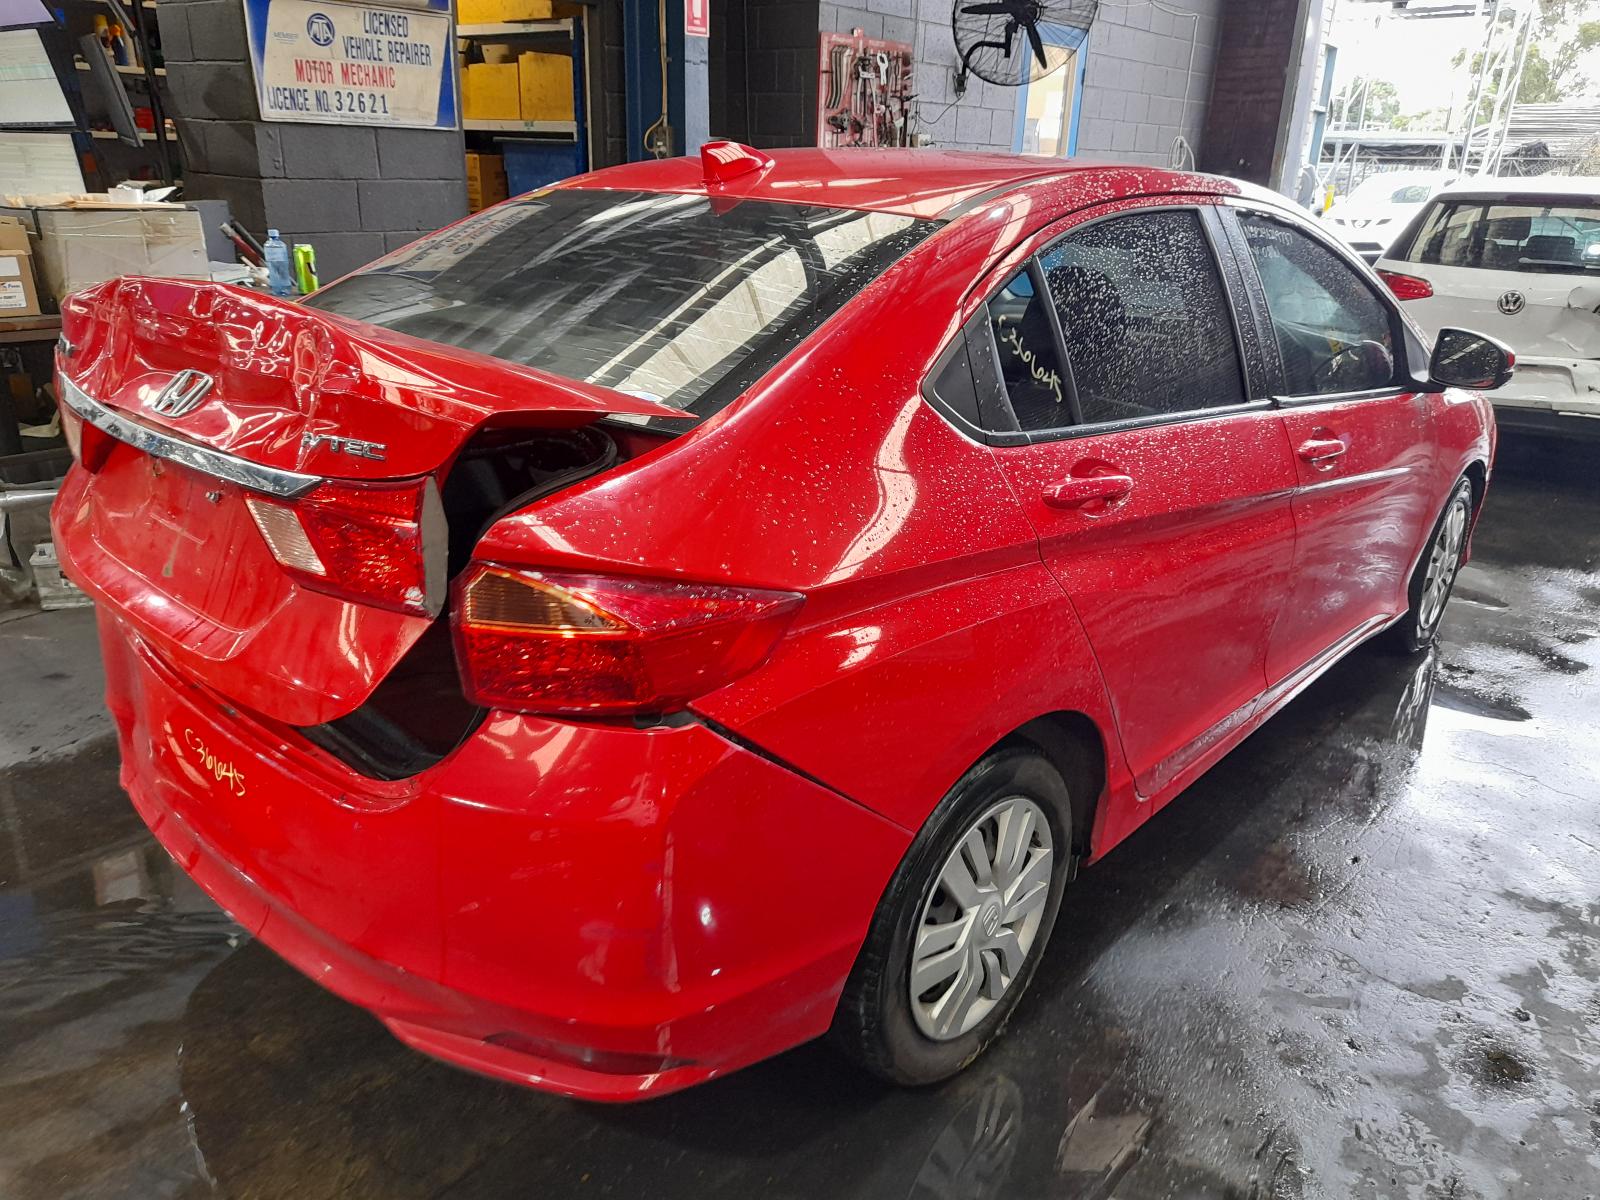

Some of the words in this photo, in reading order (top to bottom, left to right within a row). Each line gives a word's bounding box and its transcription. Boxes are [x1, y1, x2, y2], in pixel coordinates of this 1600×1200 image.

[363, 11, 409, 38] LICENSED
[342, 36, 383, 61] VEHICLE
[387, 41, 432, 66] REPAIRER
[294, 59, 334, 85] MOTOR
[340, 63, 396, 88] MECHANIC
[266, 86, 310, 112] LICENCE
[335, 91, 389, 114] 32621
